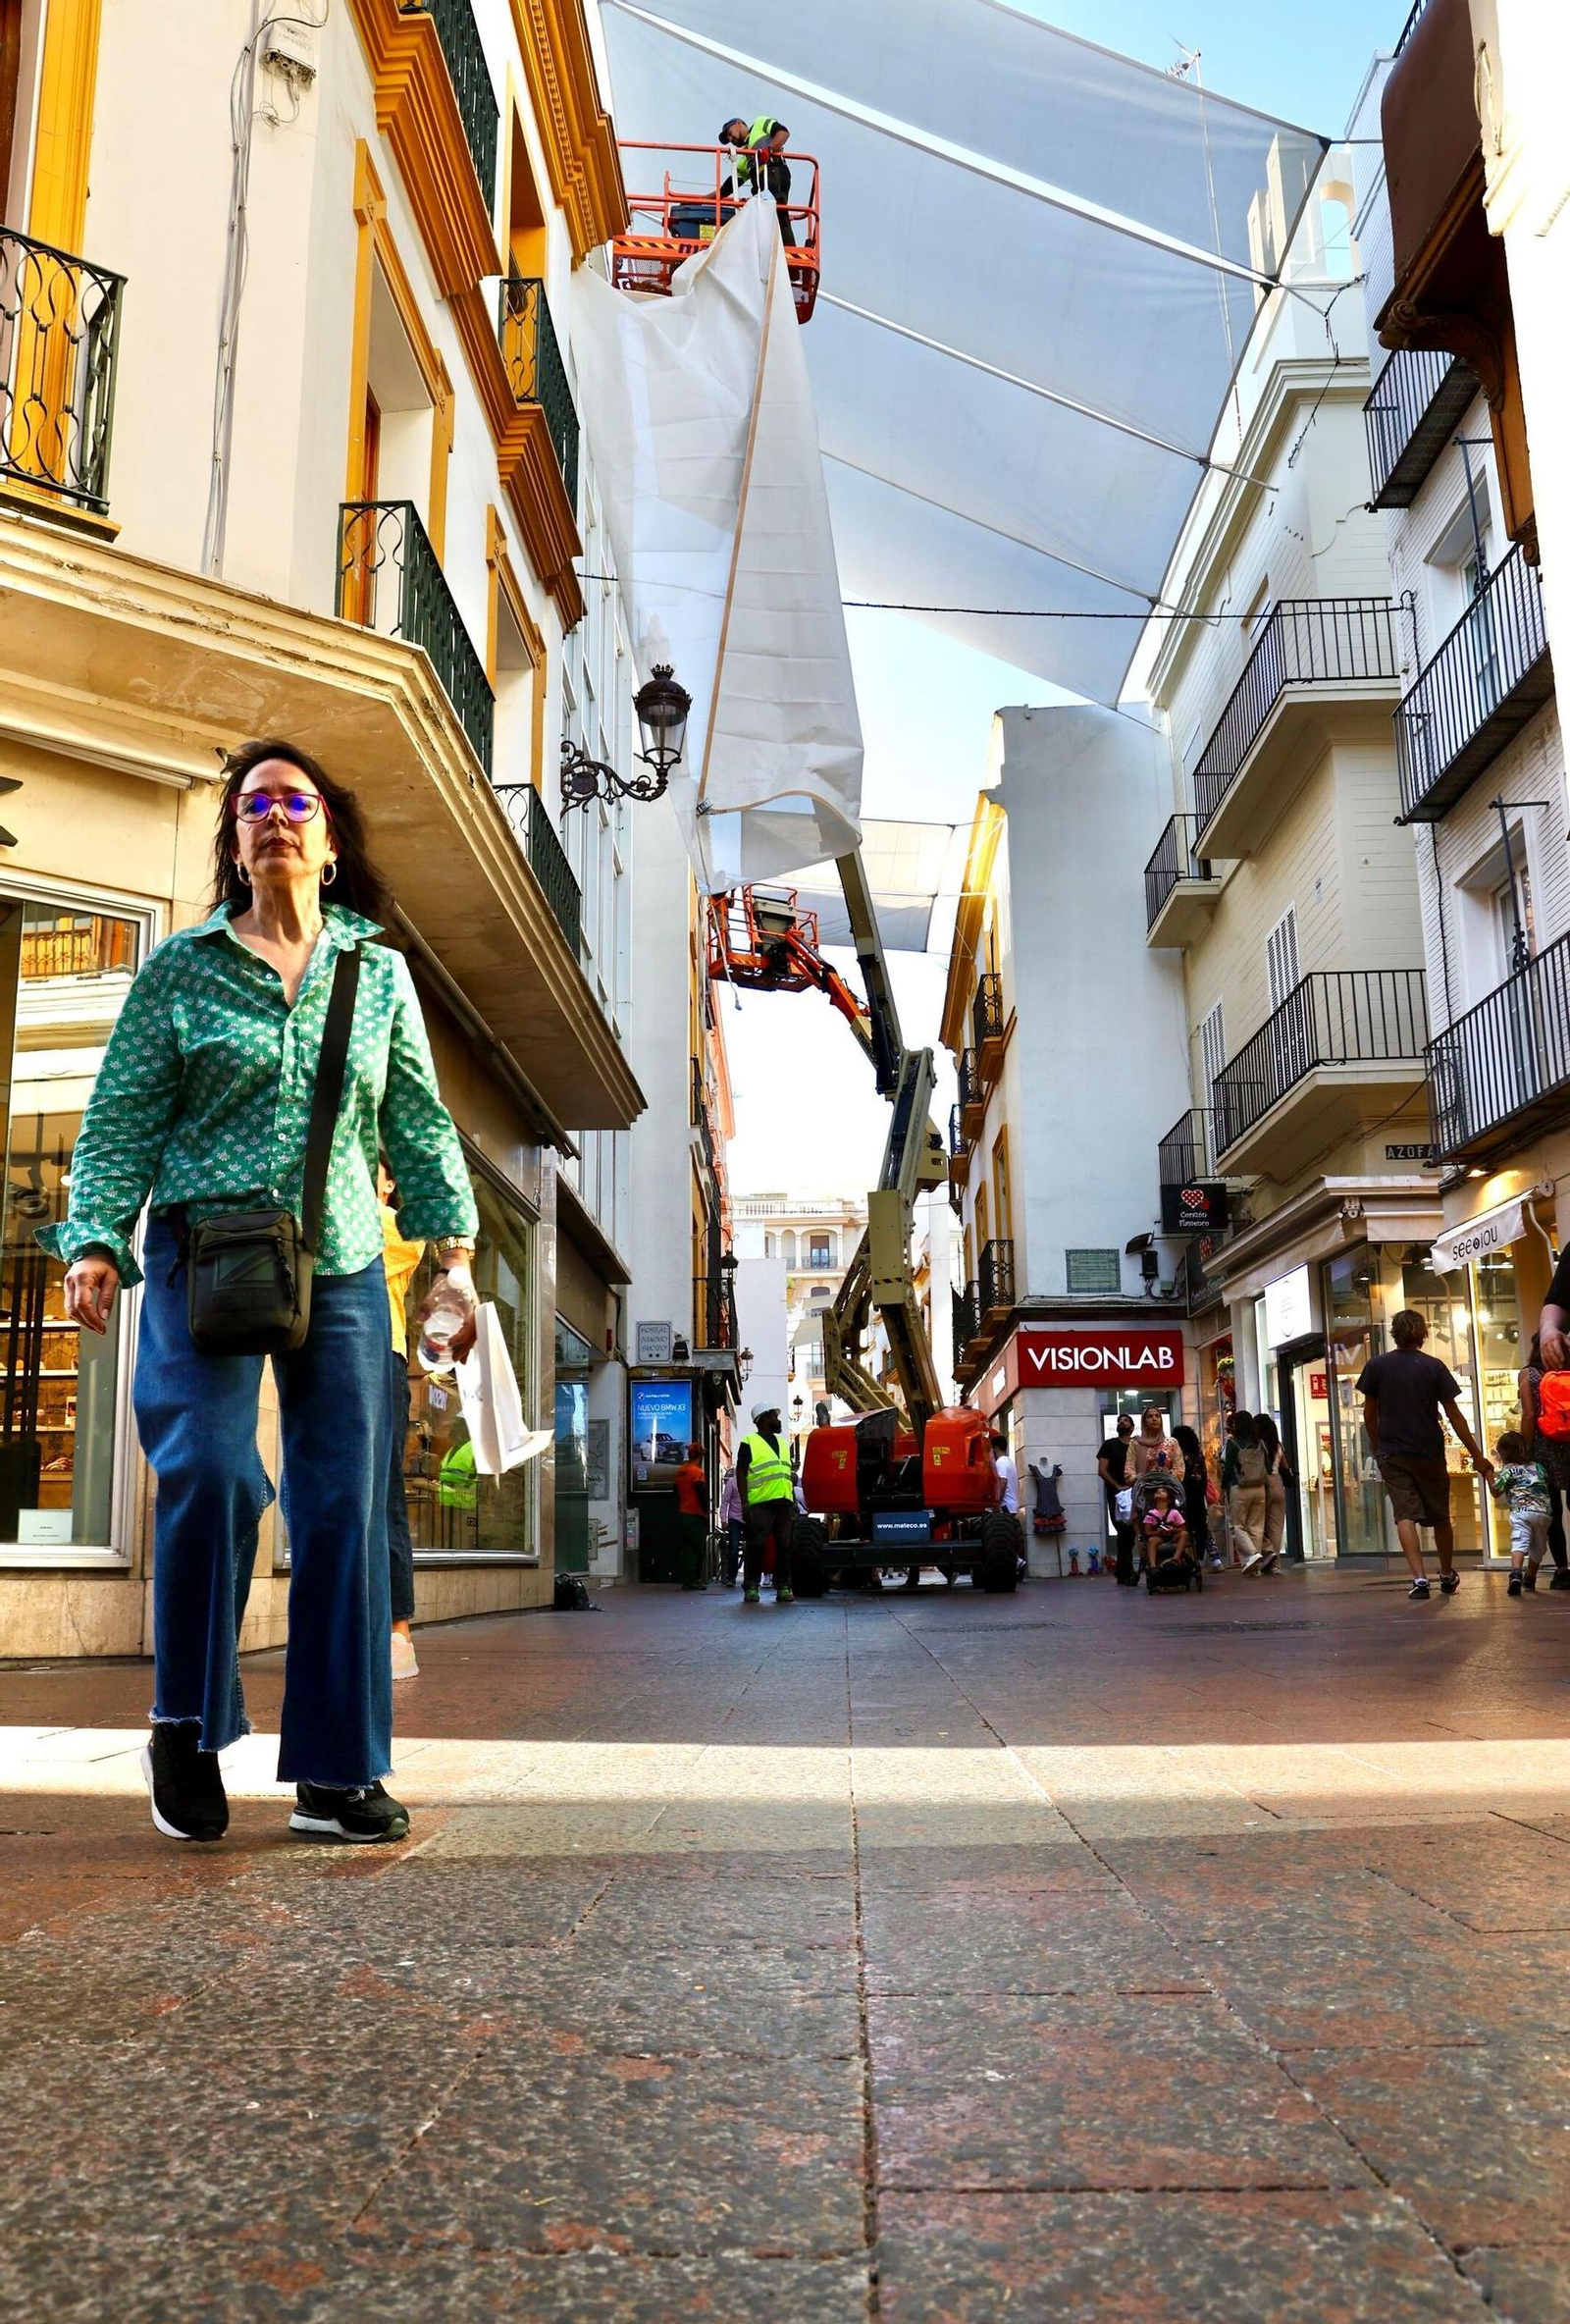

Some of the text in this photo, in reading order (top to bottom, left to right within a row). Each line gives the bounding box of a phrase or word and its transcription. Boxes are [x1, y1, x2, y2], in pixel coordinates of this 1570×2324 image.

[1387, 1145, 1436, 1159] AZOFA
[1026, 1346, 1176, 1372] VISIONLAB
[637, 1403, 660, 1412] NUEVO
